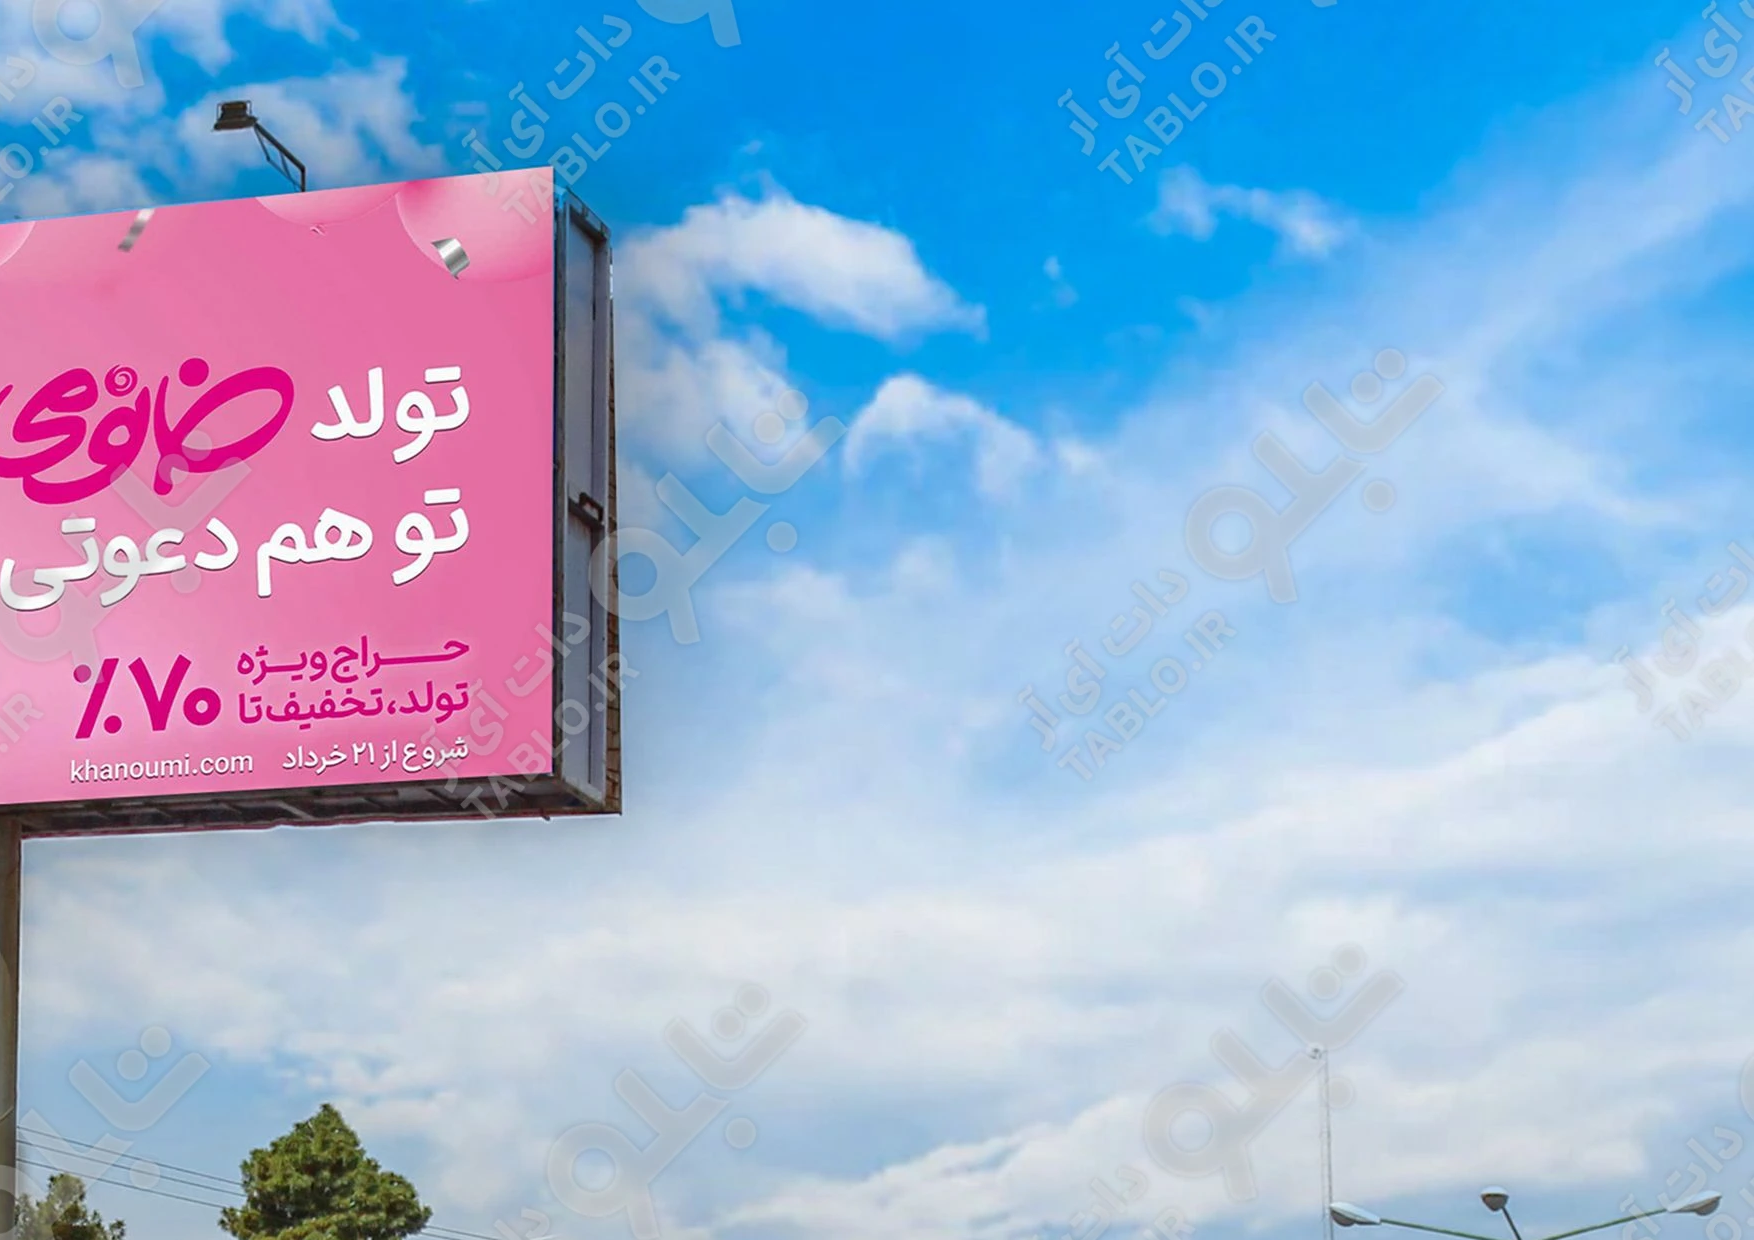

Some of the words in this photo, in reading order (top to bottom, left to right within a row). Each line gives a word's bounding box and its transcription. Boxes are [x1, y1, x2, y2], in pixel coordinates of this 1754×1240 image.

[310, 366, 469, 463] تولد
[257, 507, 373, 598] هم
[391, 488, 469, 586] تو
[237, 644, 328, 685] ویژه
[331, 635, 469, 683] حراج
[238, 693, 262, 724] تا
[266, 687, 383, 730] تخفیف
[70, 753, 253, 782] khanoumi.com
[282, 742, 347, 775] خرداد
[380, 740, 399, 769] از
[402, 737, 469, 770] شروع
